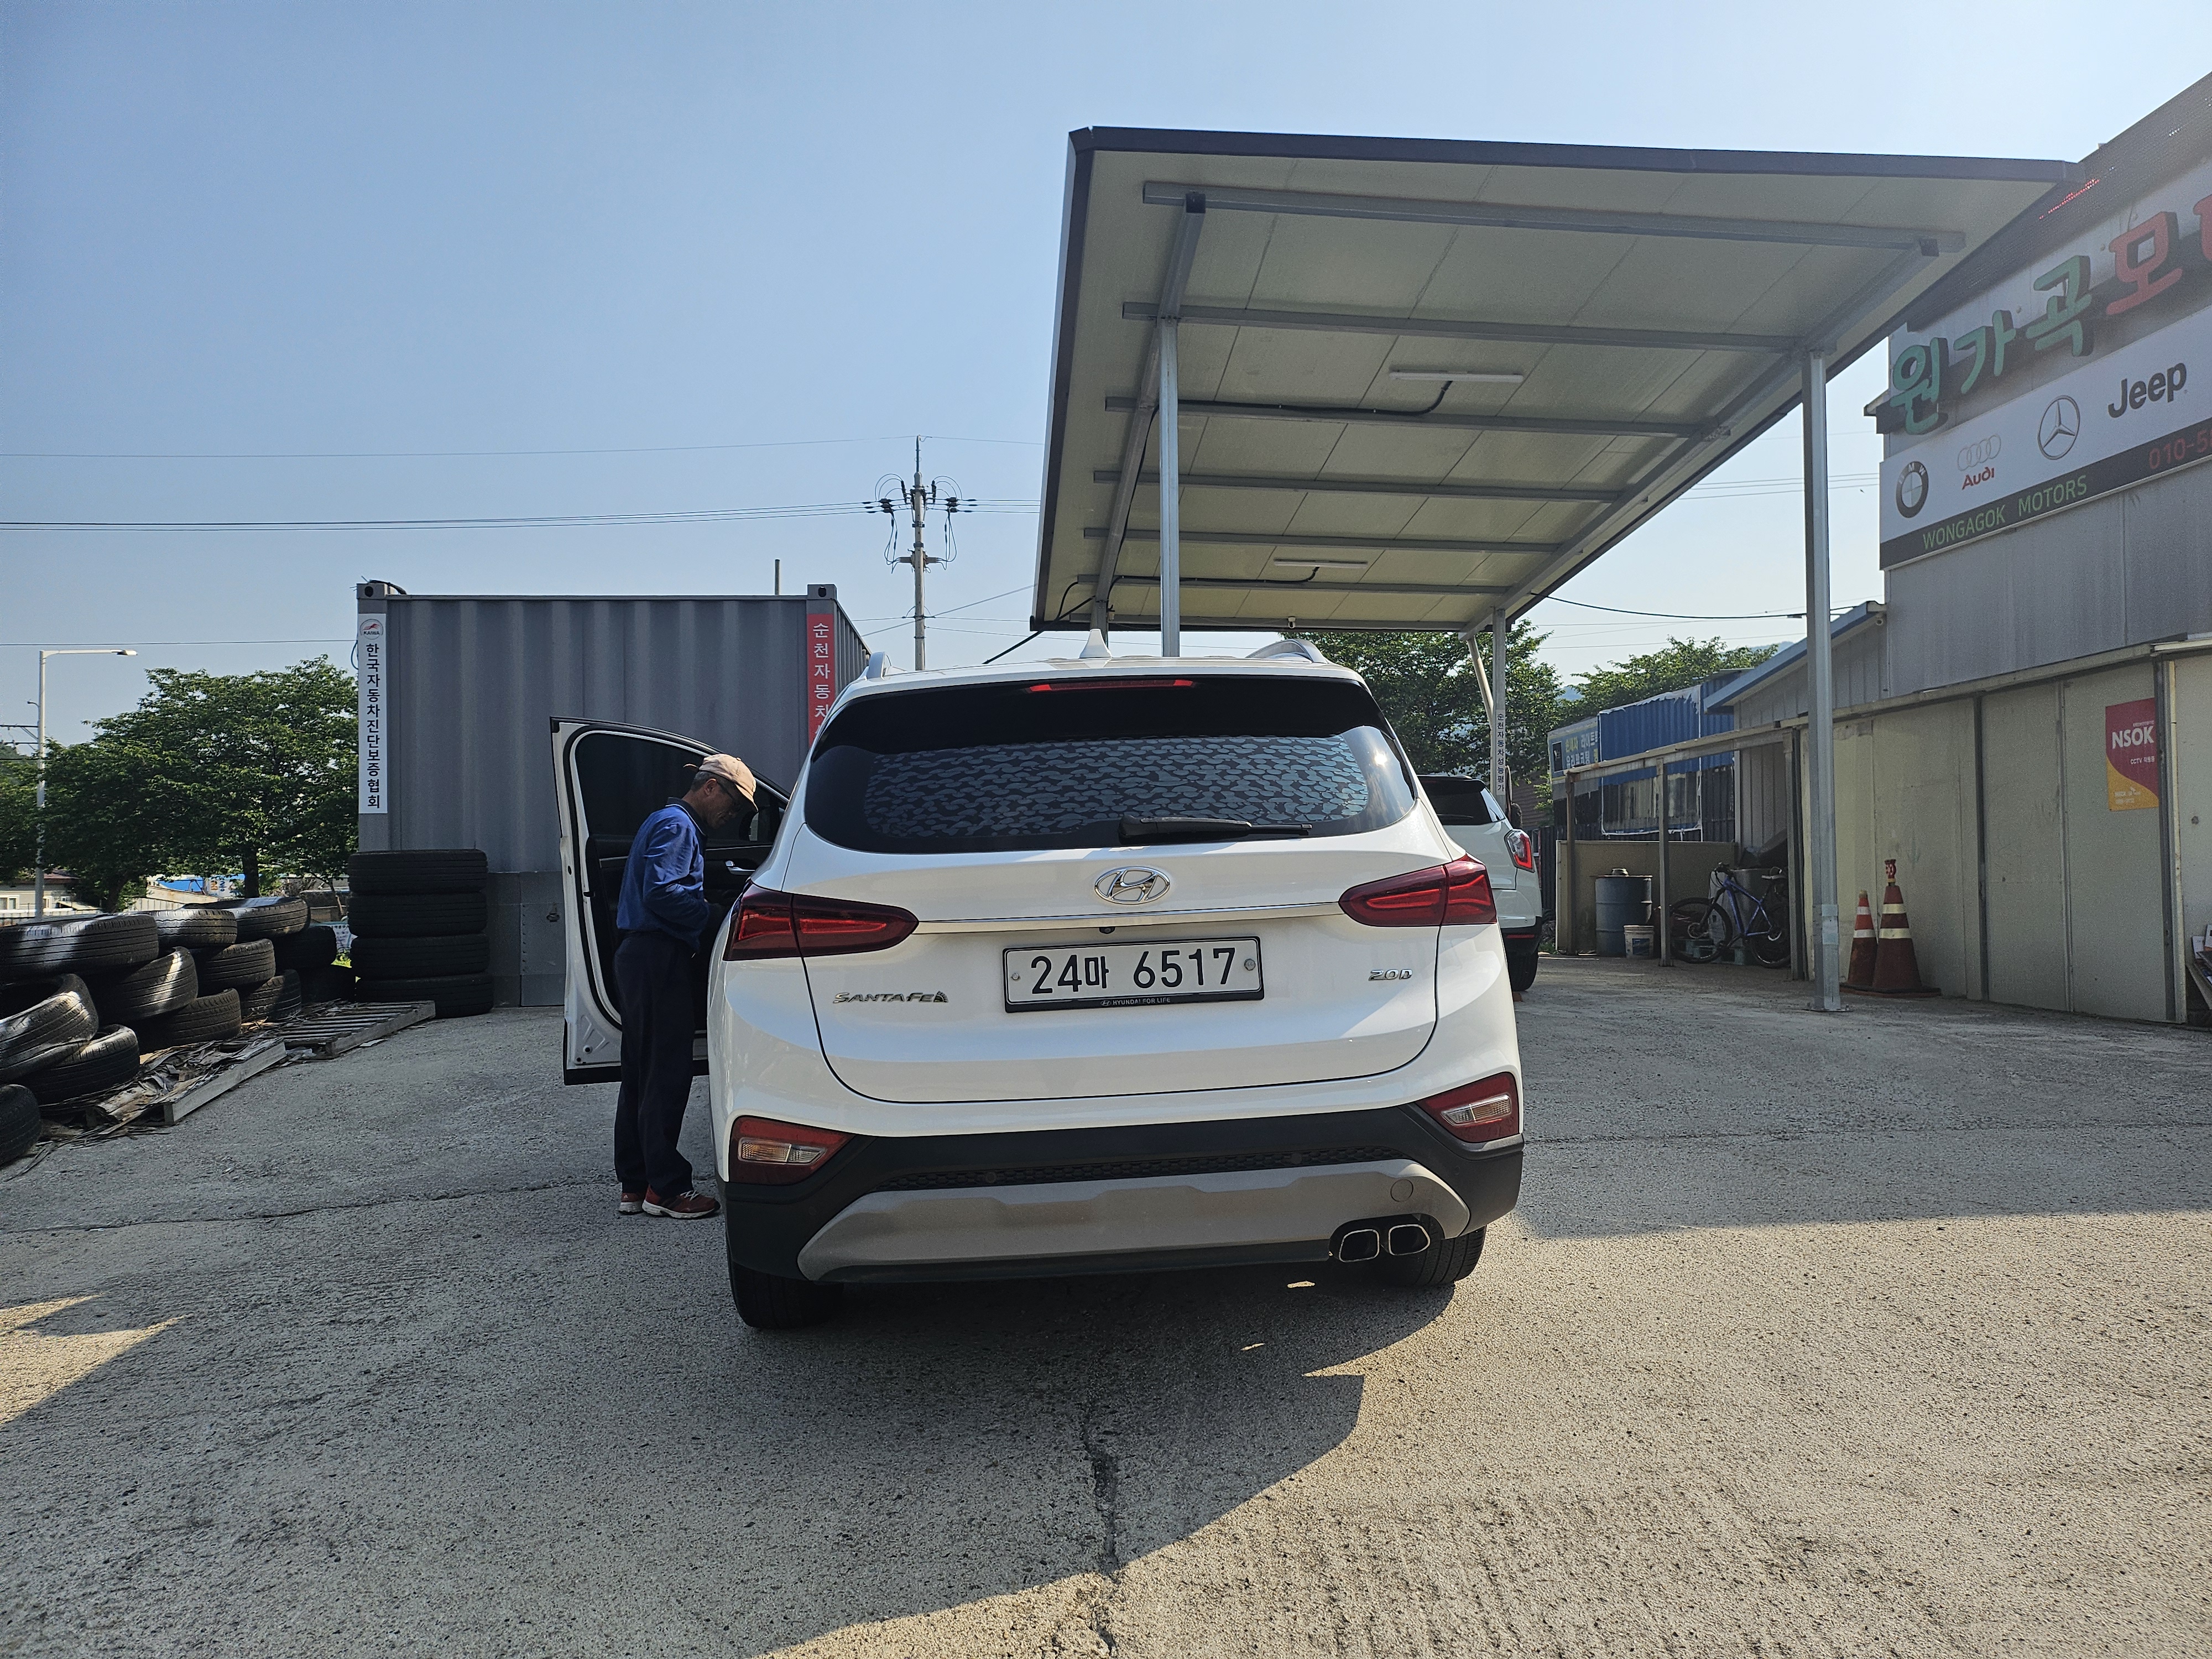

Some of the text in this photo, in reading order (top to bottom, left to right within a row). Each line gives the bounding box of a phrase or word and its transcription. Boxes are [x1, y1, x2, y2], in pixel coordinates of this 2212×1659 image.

[2107, 362, 2187, 419] Jeep
[2149, 429, 2212, 469] 010-5
[1962, 466, 1995, 490] Audi
[1923, 474, 2087, 550] WONGAGOK MOTORS
[366, 643, 380, 808] 한국자동차진단보증협회
[2112, 725, 2154, 749] NSOK
[1031, 947, 1236, 995] 24마 6517
